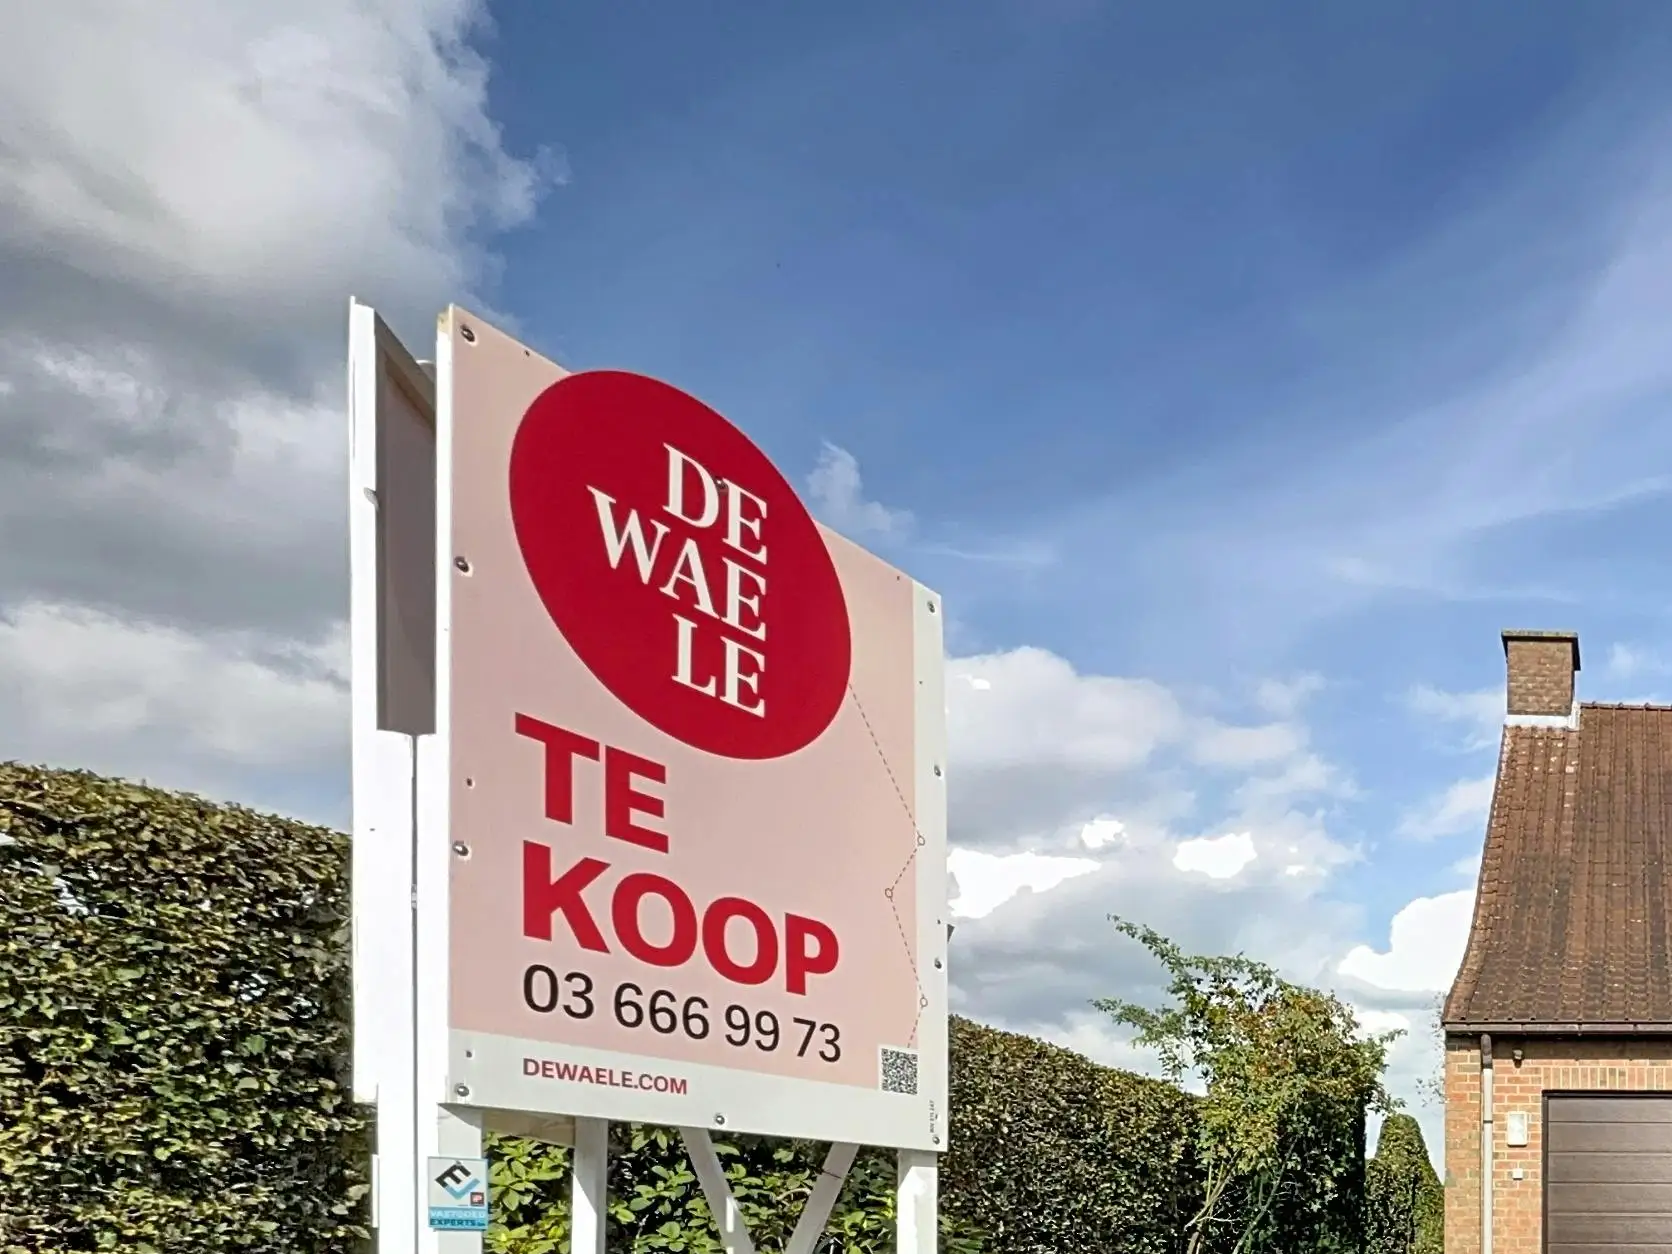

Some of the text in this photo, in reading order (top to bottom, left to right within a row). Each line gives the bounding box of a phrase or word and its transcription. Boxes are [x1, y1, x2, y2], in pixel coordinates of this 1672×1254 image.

[587, 485, 767, 642] WAE
[662, 443, 767, 565] DE
[671, 612, 766, 718] LE
[514, 713, 669, 854] TE
[522, 840, 840, 995] KOOP
[522, 964, 841, 1063] 03 666 99 73
[522, 1057, 688, 1096] DEWAELE.COM
